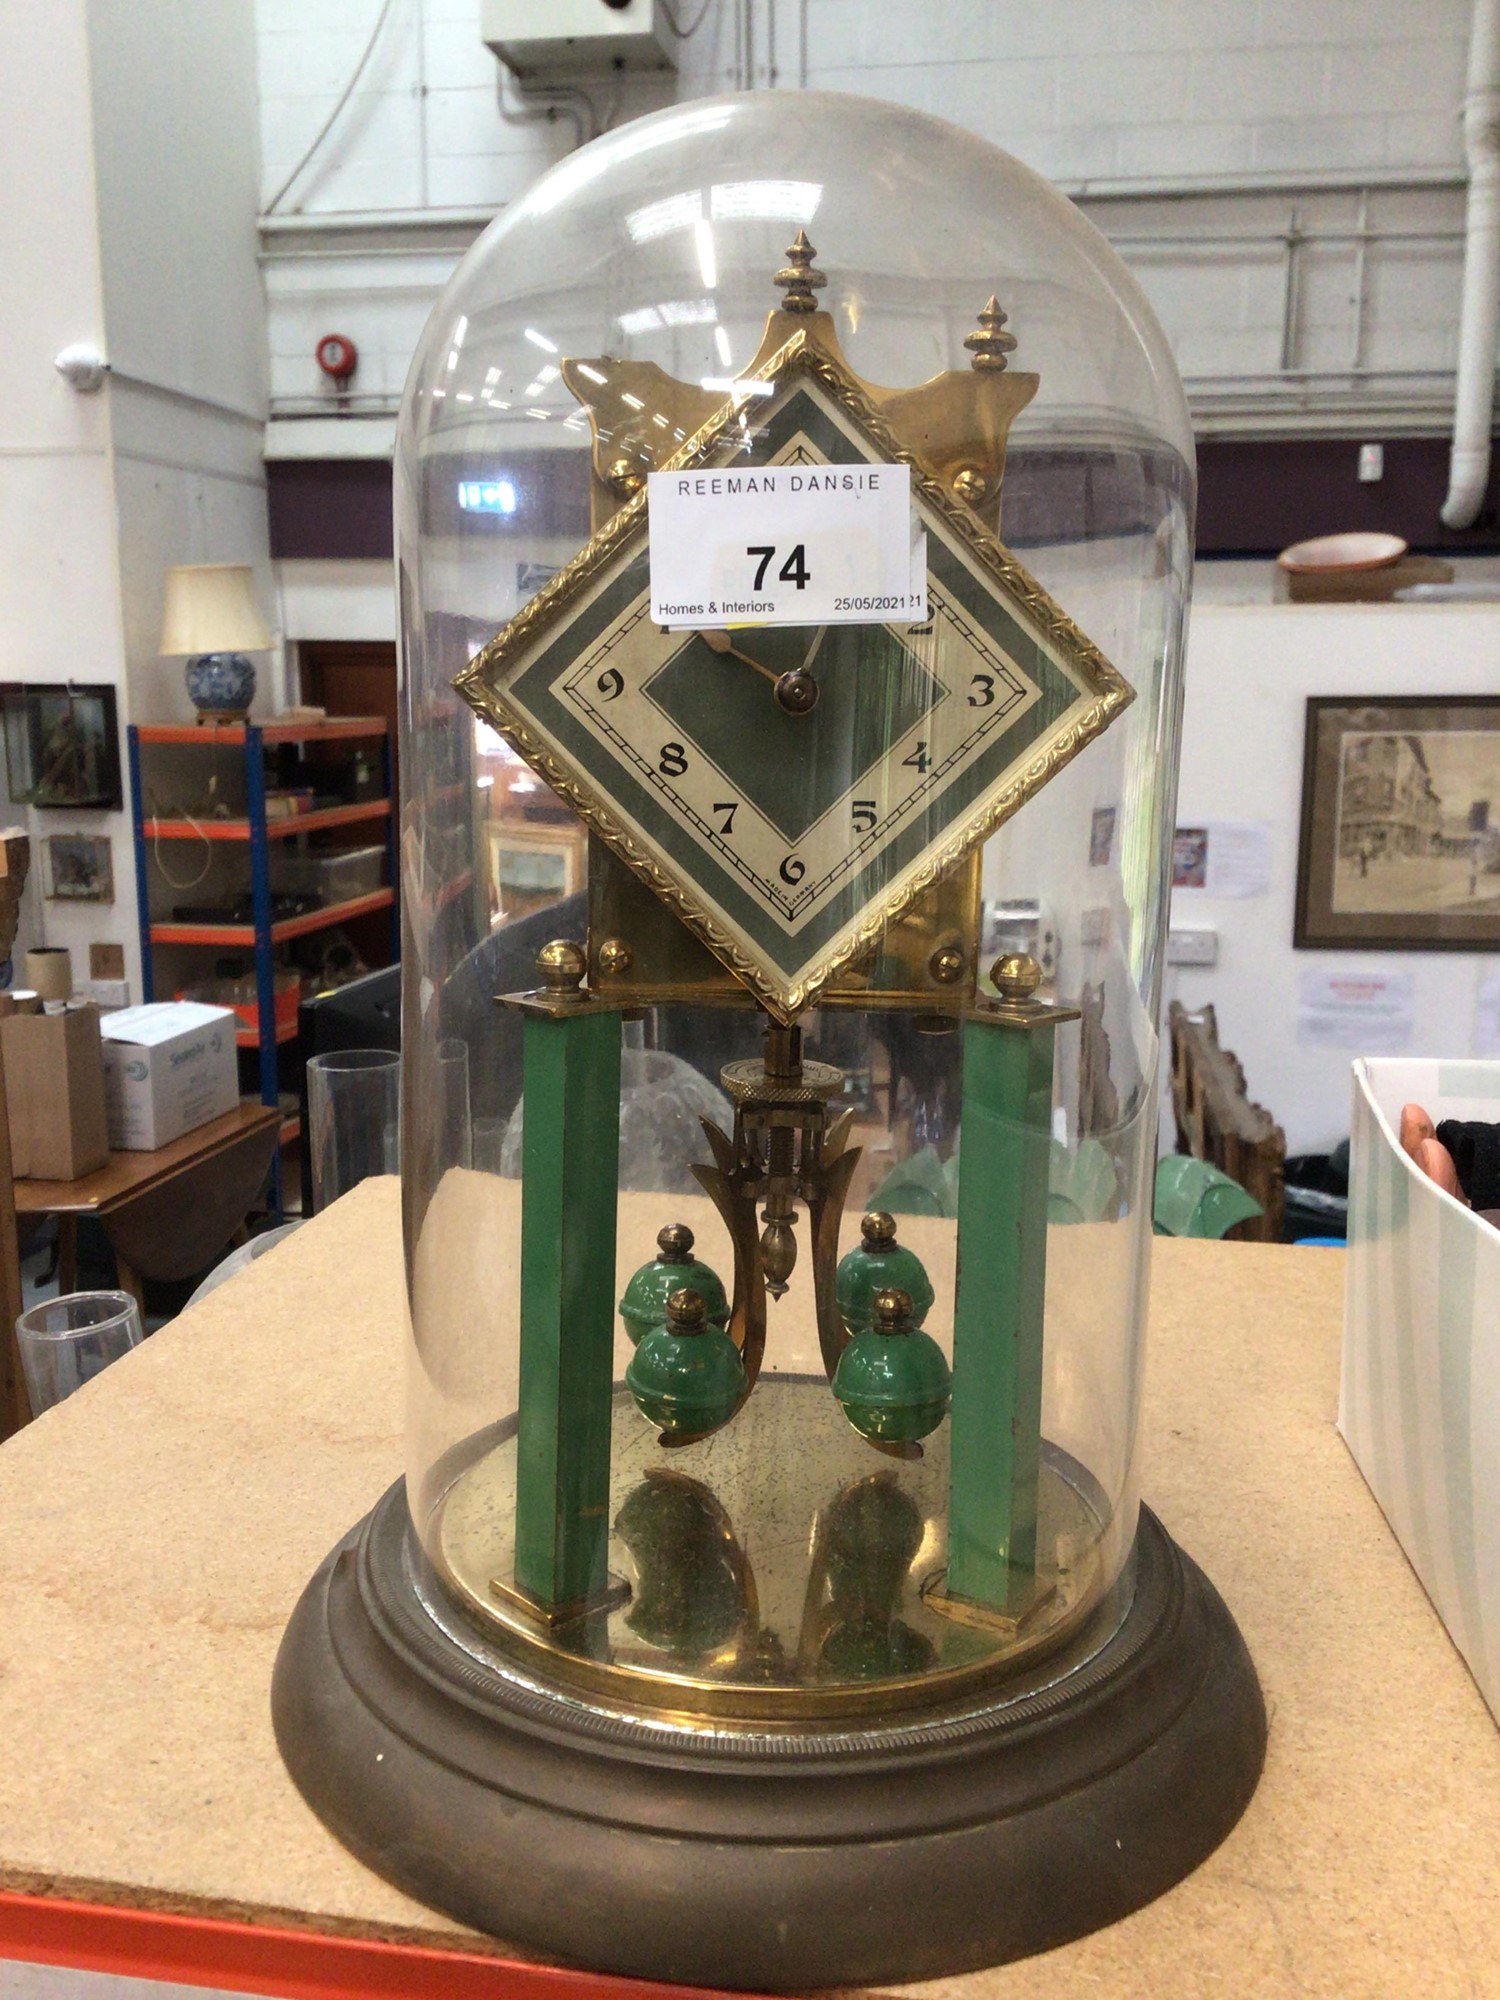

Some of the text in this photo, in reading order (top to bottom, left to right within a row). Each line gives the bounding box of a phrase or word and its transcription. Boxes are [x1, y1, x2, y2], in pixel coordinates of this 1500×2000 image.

[678, 473, 880, 496] REEMAN DANSIE
[747, 544, 811, 591] 74
[658, 596, 905, 615] Homes & Interiors 25/05/2021
[597, 668, 624, 701] 9
[966, 675, 994, 707] 3
[658, 742, 688, 777] 8
[902, 742, 932, 773] 4
[712, 803, 738, 834] 7
[851, 801, 877, 832] 5
[779, 853, 805, 886] 6
[789, 880, 816, 906] GERMANY
